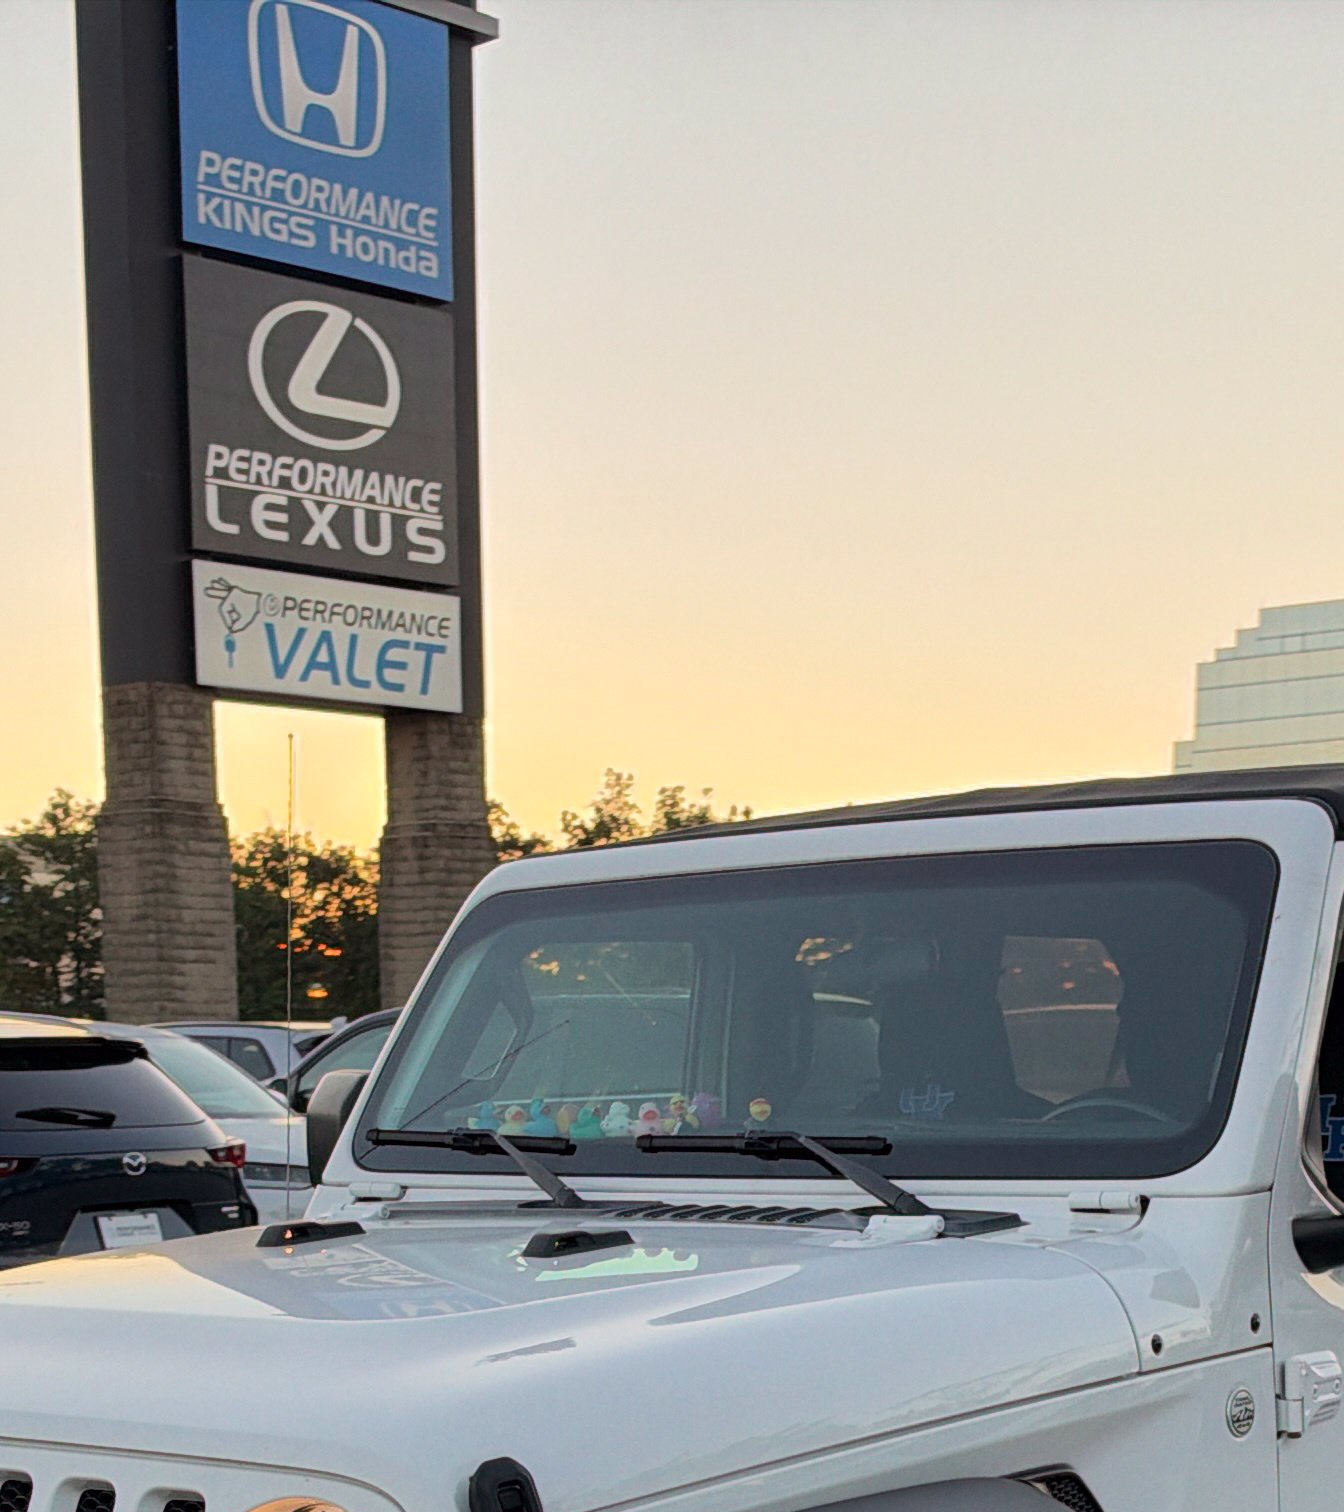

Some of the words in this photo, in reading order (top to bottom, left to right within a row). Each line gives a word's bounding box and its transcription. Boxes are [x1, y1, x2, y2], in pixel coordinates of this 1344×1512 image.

[196, 150, 438, 240] PERFORMANCE
[197, 194, 316, 249] KINGS
[330, 225, 439, 279] Honda
[205, 443, 443, 514] PERFORMANCE
[205, 484, 446, 565] LEXUS
[281, 596, 451, 639] PERFORMANCE
[264, 622, 447, 696] VALET
